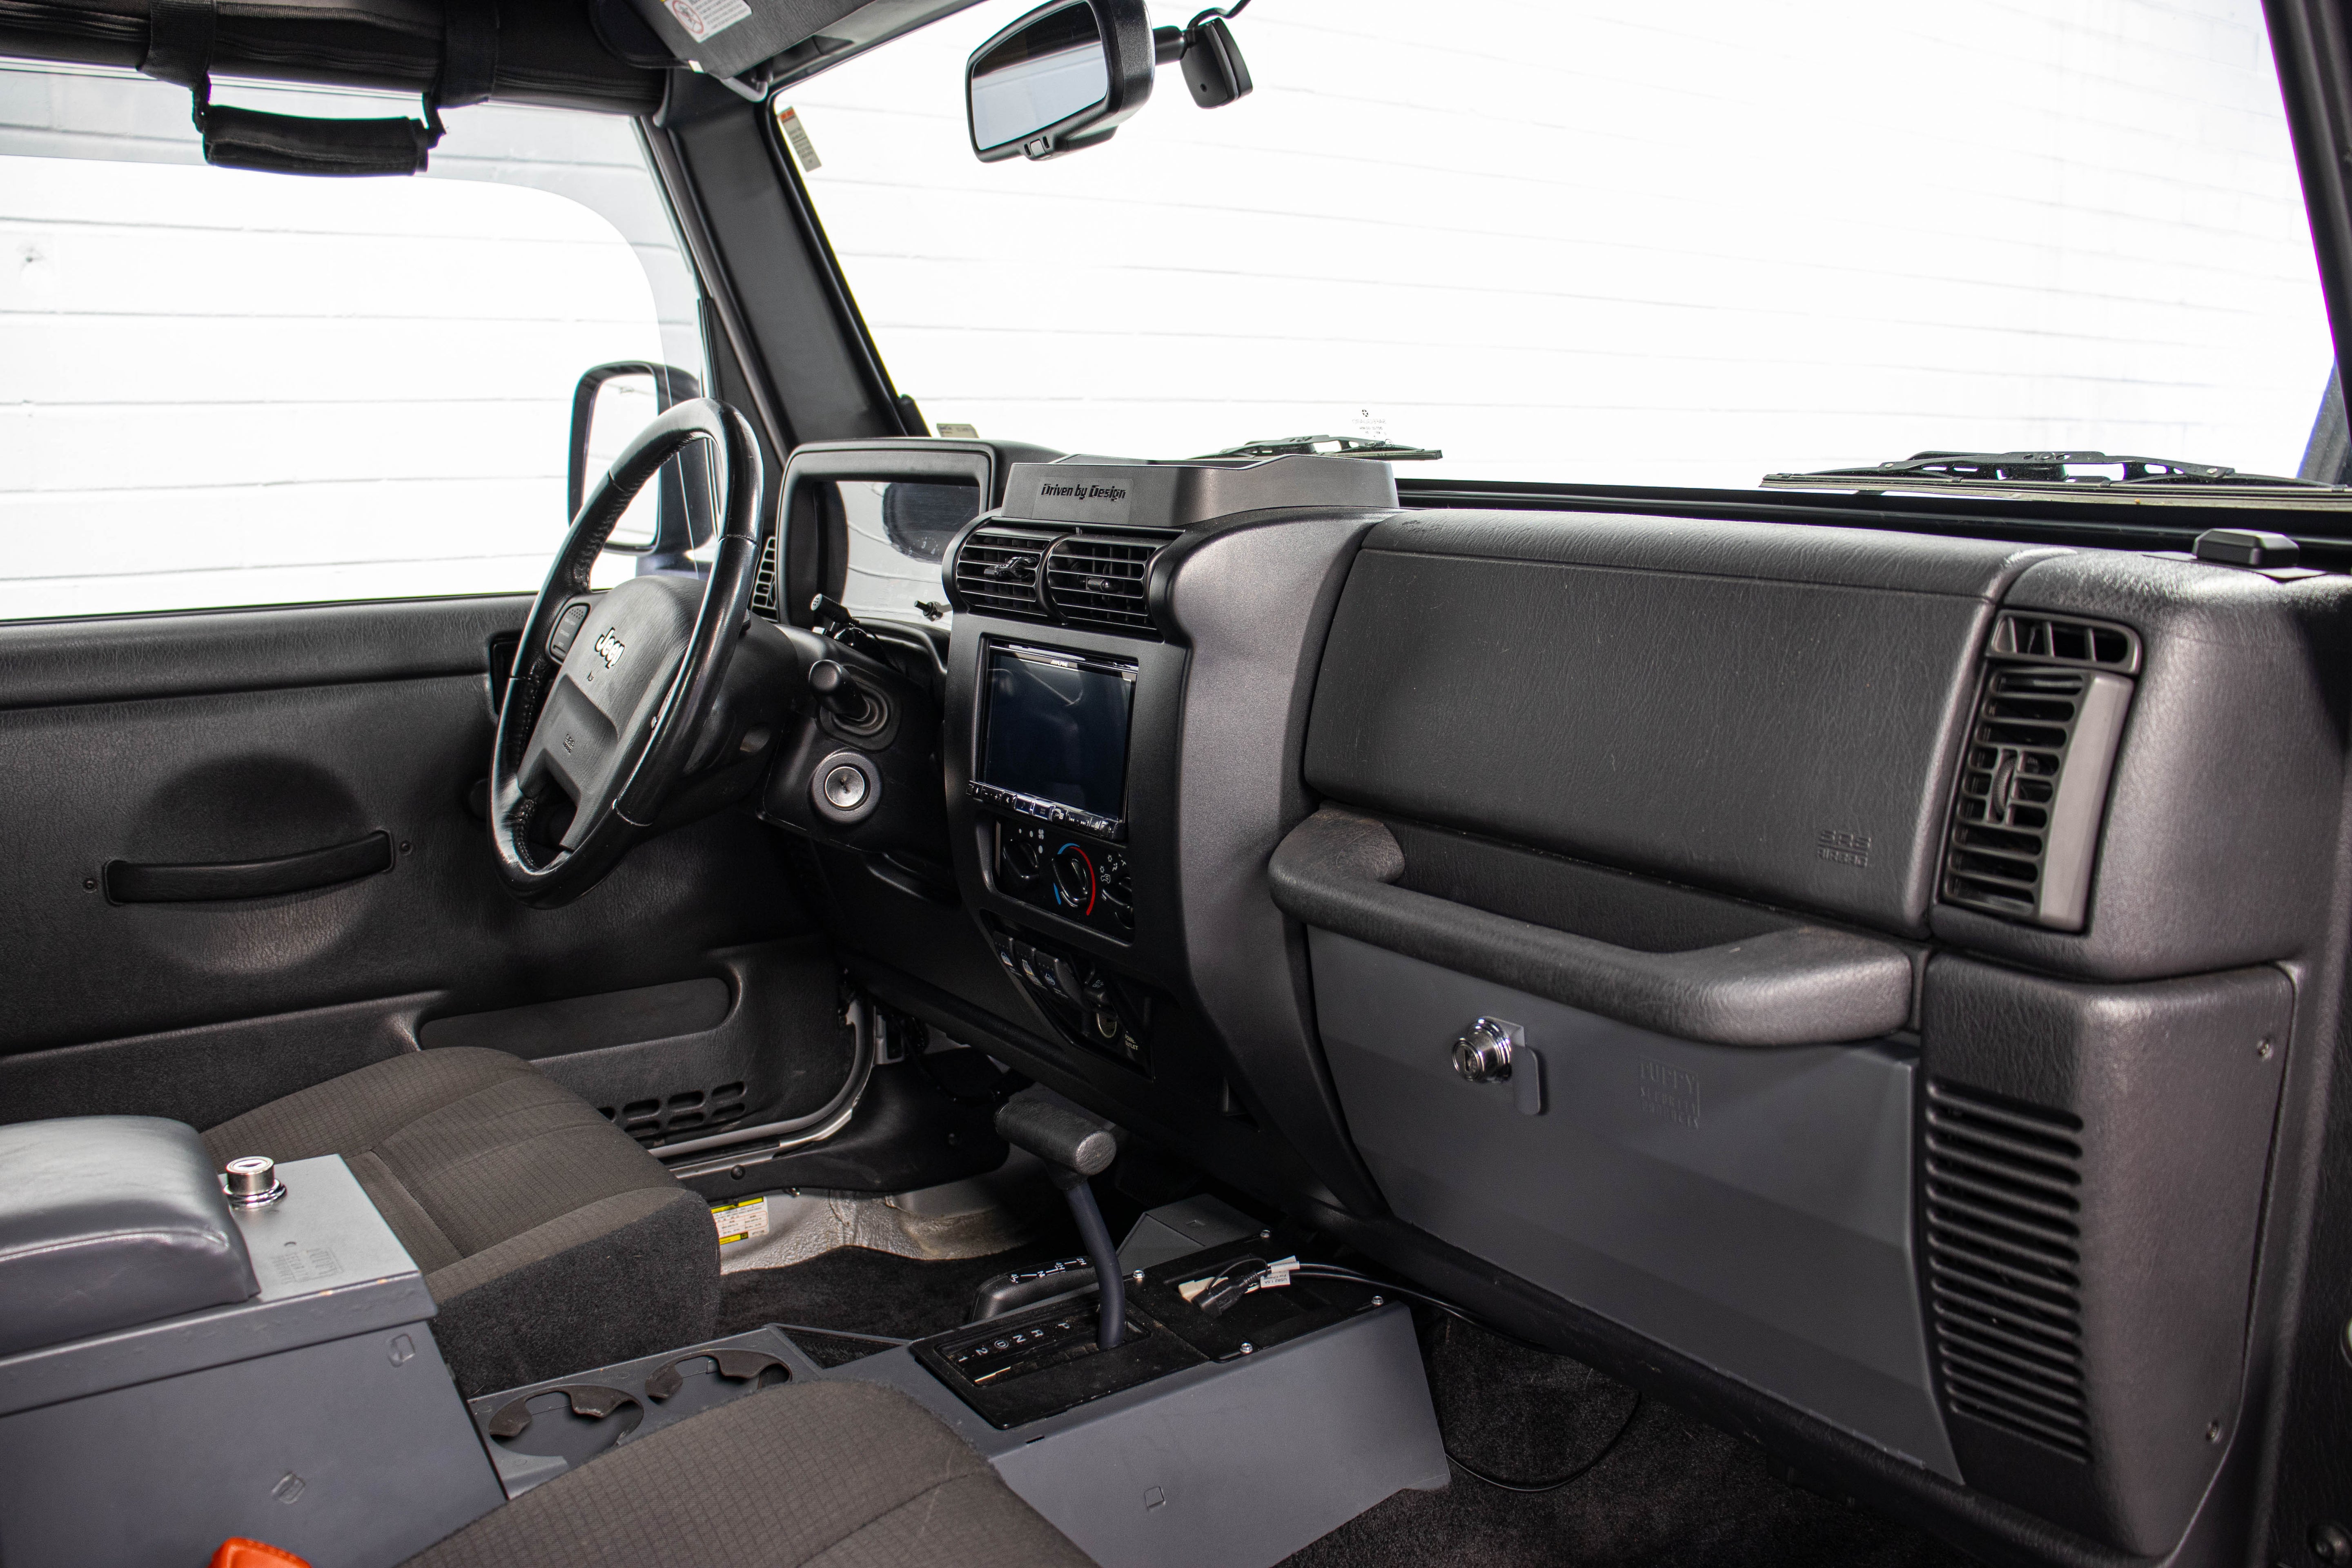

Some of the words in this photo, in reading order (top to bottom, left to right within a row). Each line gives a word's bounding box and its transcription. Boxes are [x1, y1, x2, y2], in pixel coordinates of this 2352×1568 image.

[1041, 483, 1073, 497] Driven
[1074, 484, 1088, 500] by
[1088, 485, 1126, 501] Design
[921, 541, 927, 549] 3
[930, 548, 936, 556] 4
[594, 626, 625, 669] Jeep
[1125, 1034, 1136, 1044] POWE
[1125, 1040, 1138, 1051] OUTLET
[1013, 1334, 1026, 1343] N
[976, 1348, 988, 1356] 2
